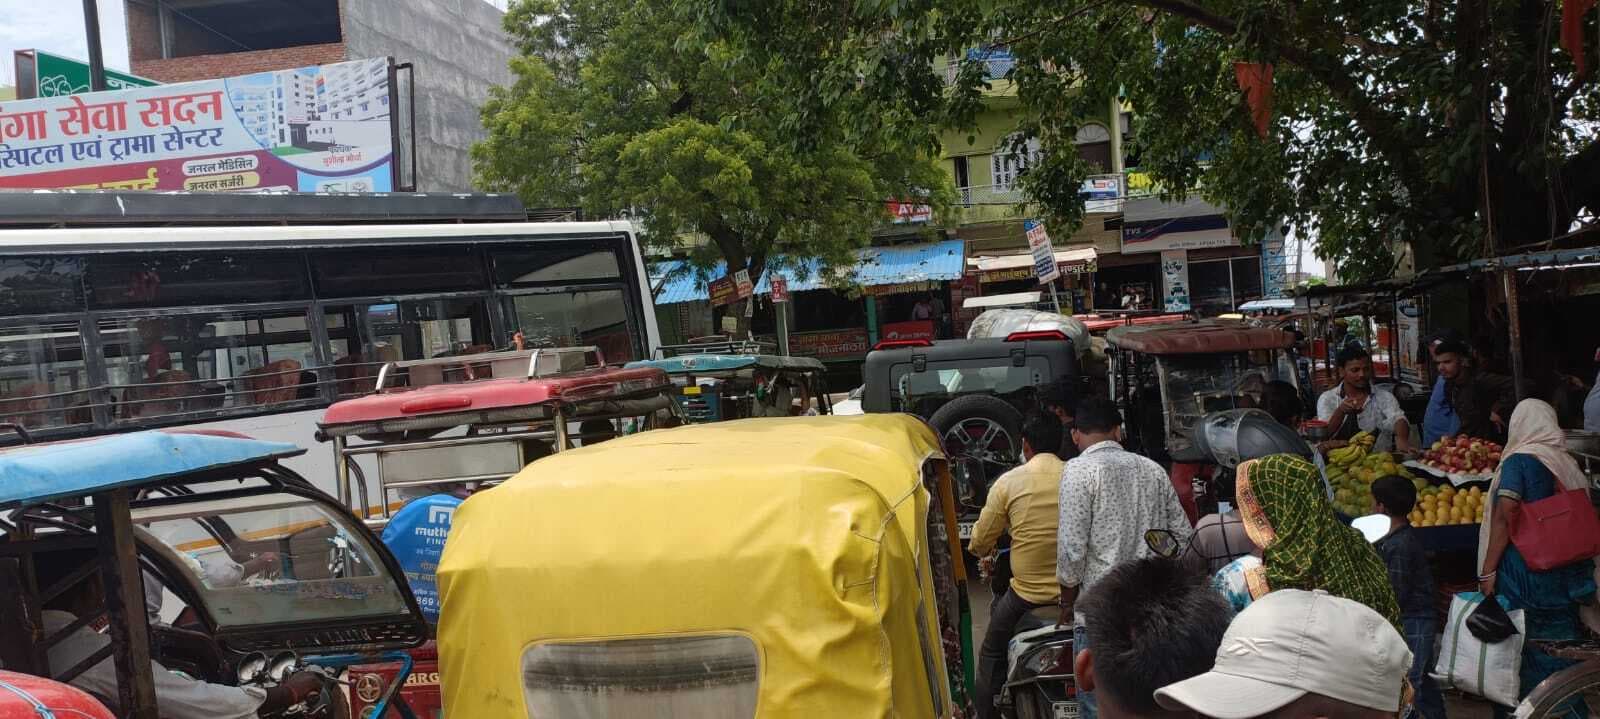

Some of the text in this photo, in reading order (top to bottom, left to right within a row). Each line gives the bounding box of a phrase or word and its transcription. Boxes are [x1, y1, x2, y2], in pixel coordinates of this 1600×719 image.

[56, 95, 128, 135] सेवा
[136, 90, 223, 128] सदन
[70, 135, 102, 161] एवं
[107, 134, 156, 161] ट्रामा
[160, 125, 223, 152] सेन्टर
[188, 163, 216, 174] जनरल
[189, 180, 218, 191] जनरल
[415, 527, 448, 537] muth
[406, 672, 440, 685] ARG
